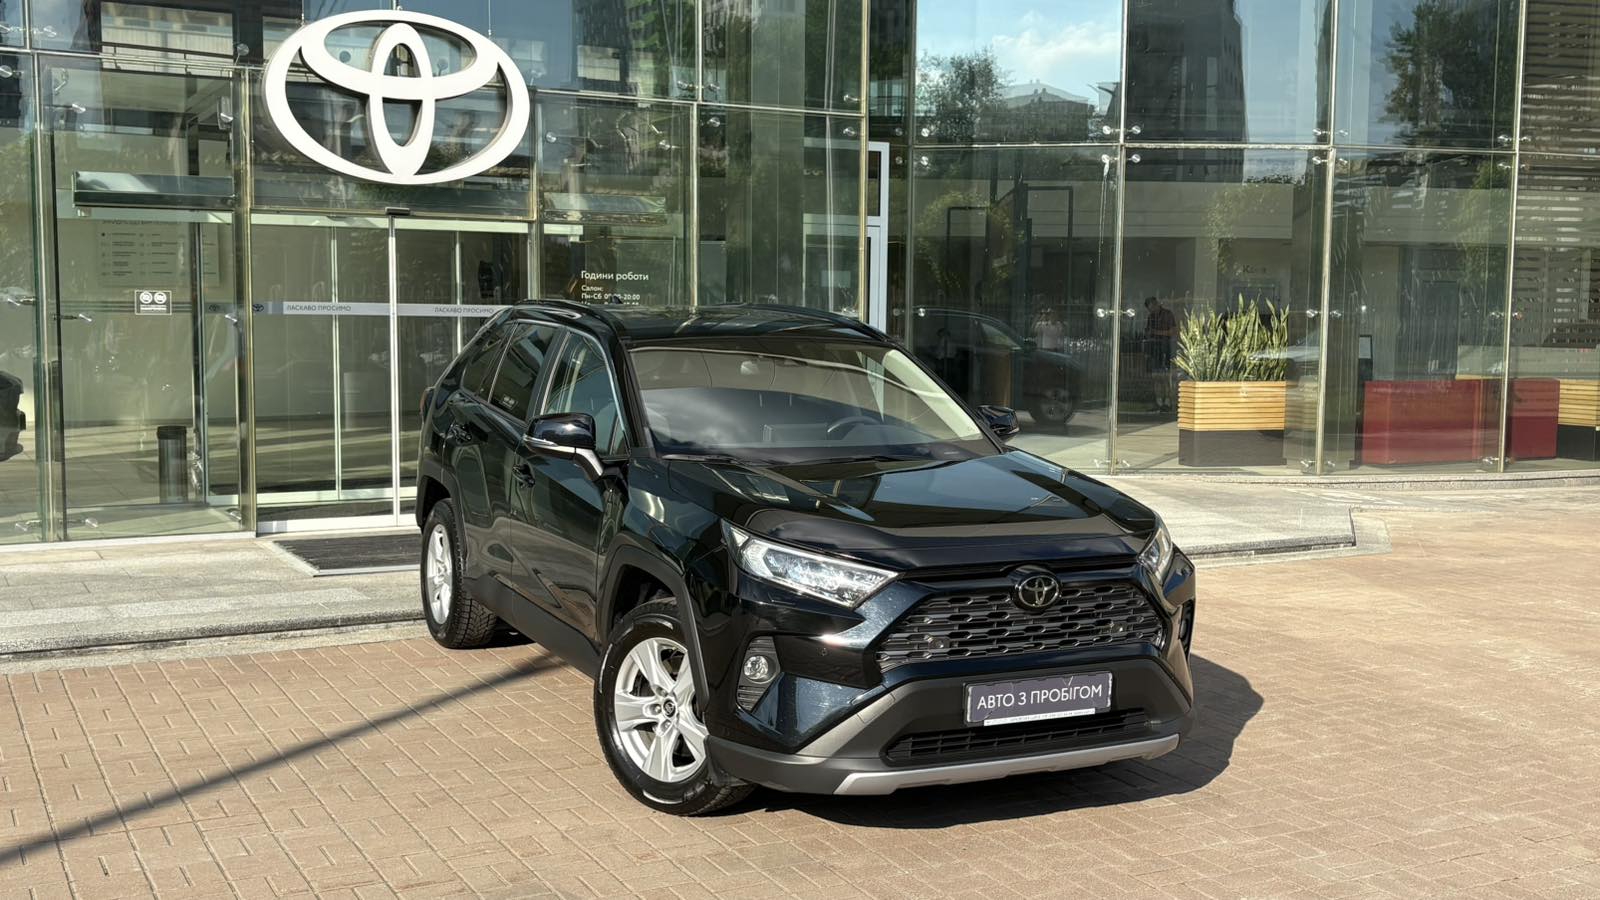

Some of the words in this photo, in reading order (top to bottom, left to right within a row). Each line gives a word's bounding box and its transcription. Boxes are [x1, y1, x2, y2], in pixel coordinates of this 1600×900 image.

[581, 270, 614, 280] Години
[616, 271, 649, 282] роботи
[581, 284, 604, 292] Салон:
[287, 304, 317, 312] ЛАСКАВО
[318, 304, 352, 312] ПРОСИМО
[434, 306, 462, 314] ЛАСКАВО
[463, 307, 495, 315] ПРОСИМО
[977, 694, 1015, 710] АВТО
[1030, 684, 1102, 705] ПРОБІГОМ
